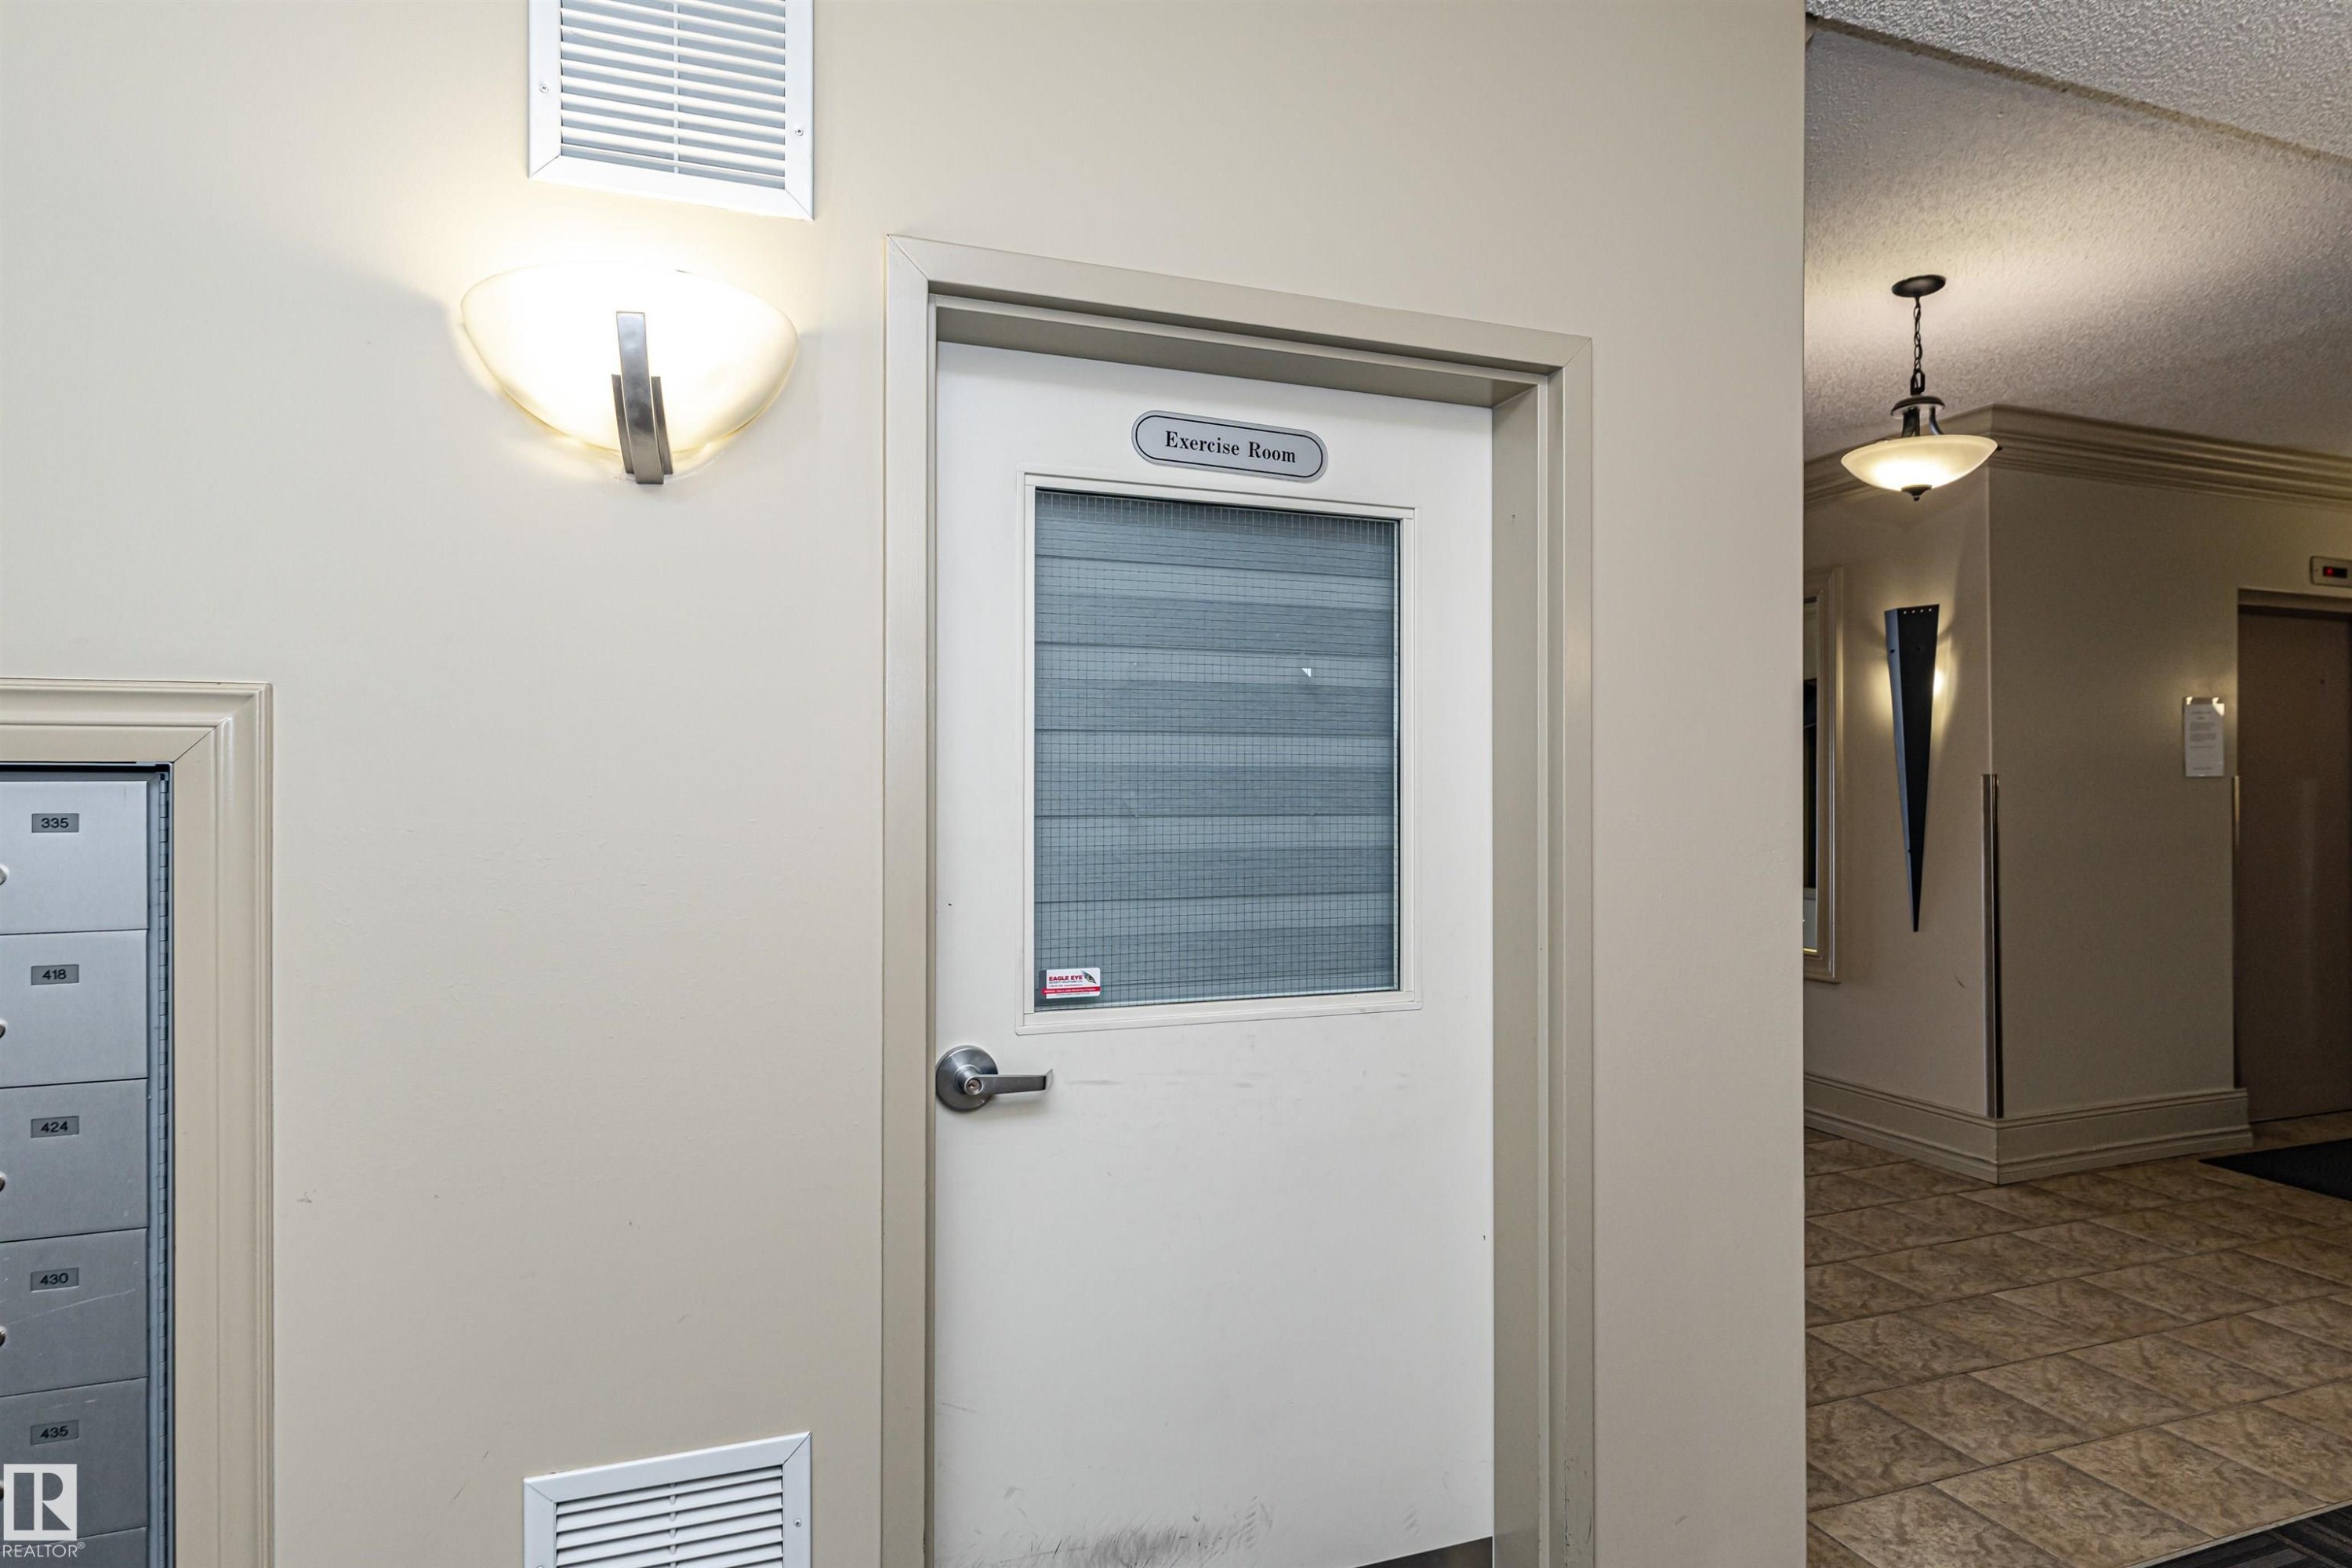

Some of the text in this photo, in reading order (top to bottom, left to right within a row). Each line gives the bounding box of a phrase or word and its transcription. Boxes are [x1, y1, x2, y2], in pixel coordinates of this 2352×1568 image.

[1165, 430, 1296, 463] Exercise Room
[41, 817, 69, 829] 335
[42, 968, 67, 980] 418
[40, 1120, 69, 1133] 424
[39, 1272, 69, 1285] 430
[40, 1425, 69, 1439] 435
